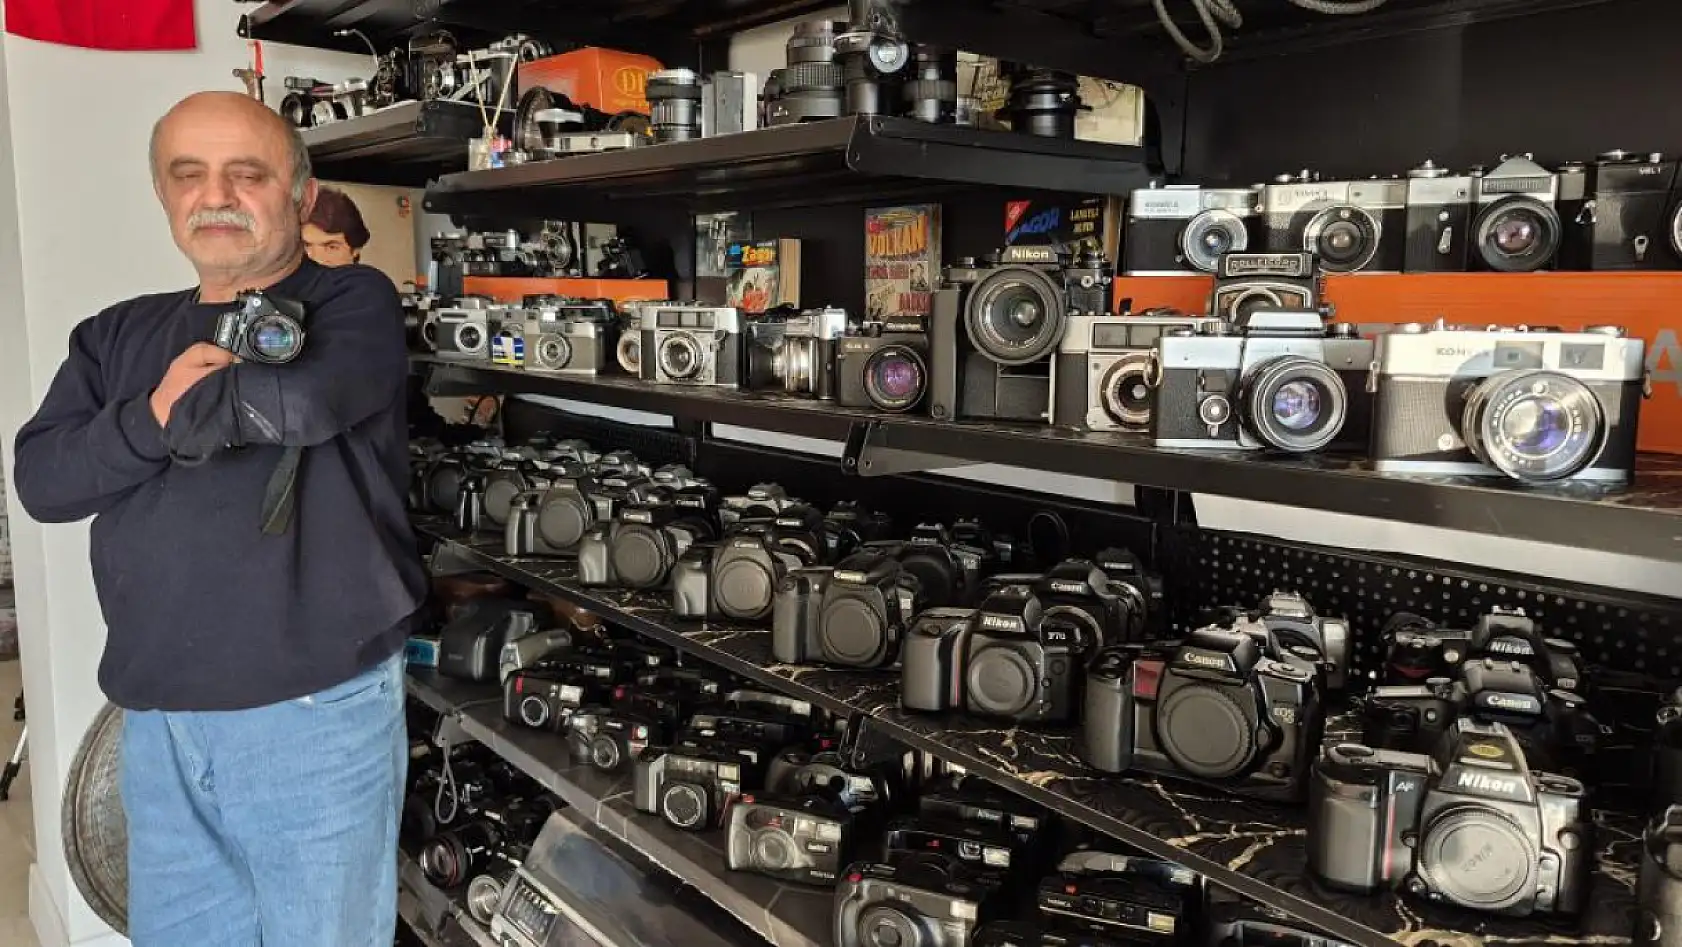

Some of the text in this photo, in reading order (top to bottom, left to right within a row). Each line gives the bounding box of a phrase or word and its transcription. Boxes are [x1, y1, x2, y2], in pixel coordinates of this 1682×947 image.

[1011, 248, 1049, 259] Nikon
[983, 615, 1018, 629] Nikon
[1489, 641, 1534, 655] Nikon
[1183, 652, 1225, 669] Canon
[1486, 695, 1531, 709] Canon
[1395, 781, 1414, 792] AF
[1457, 772, 1516, 793] Nikon
